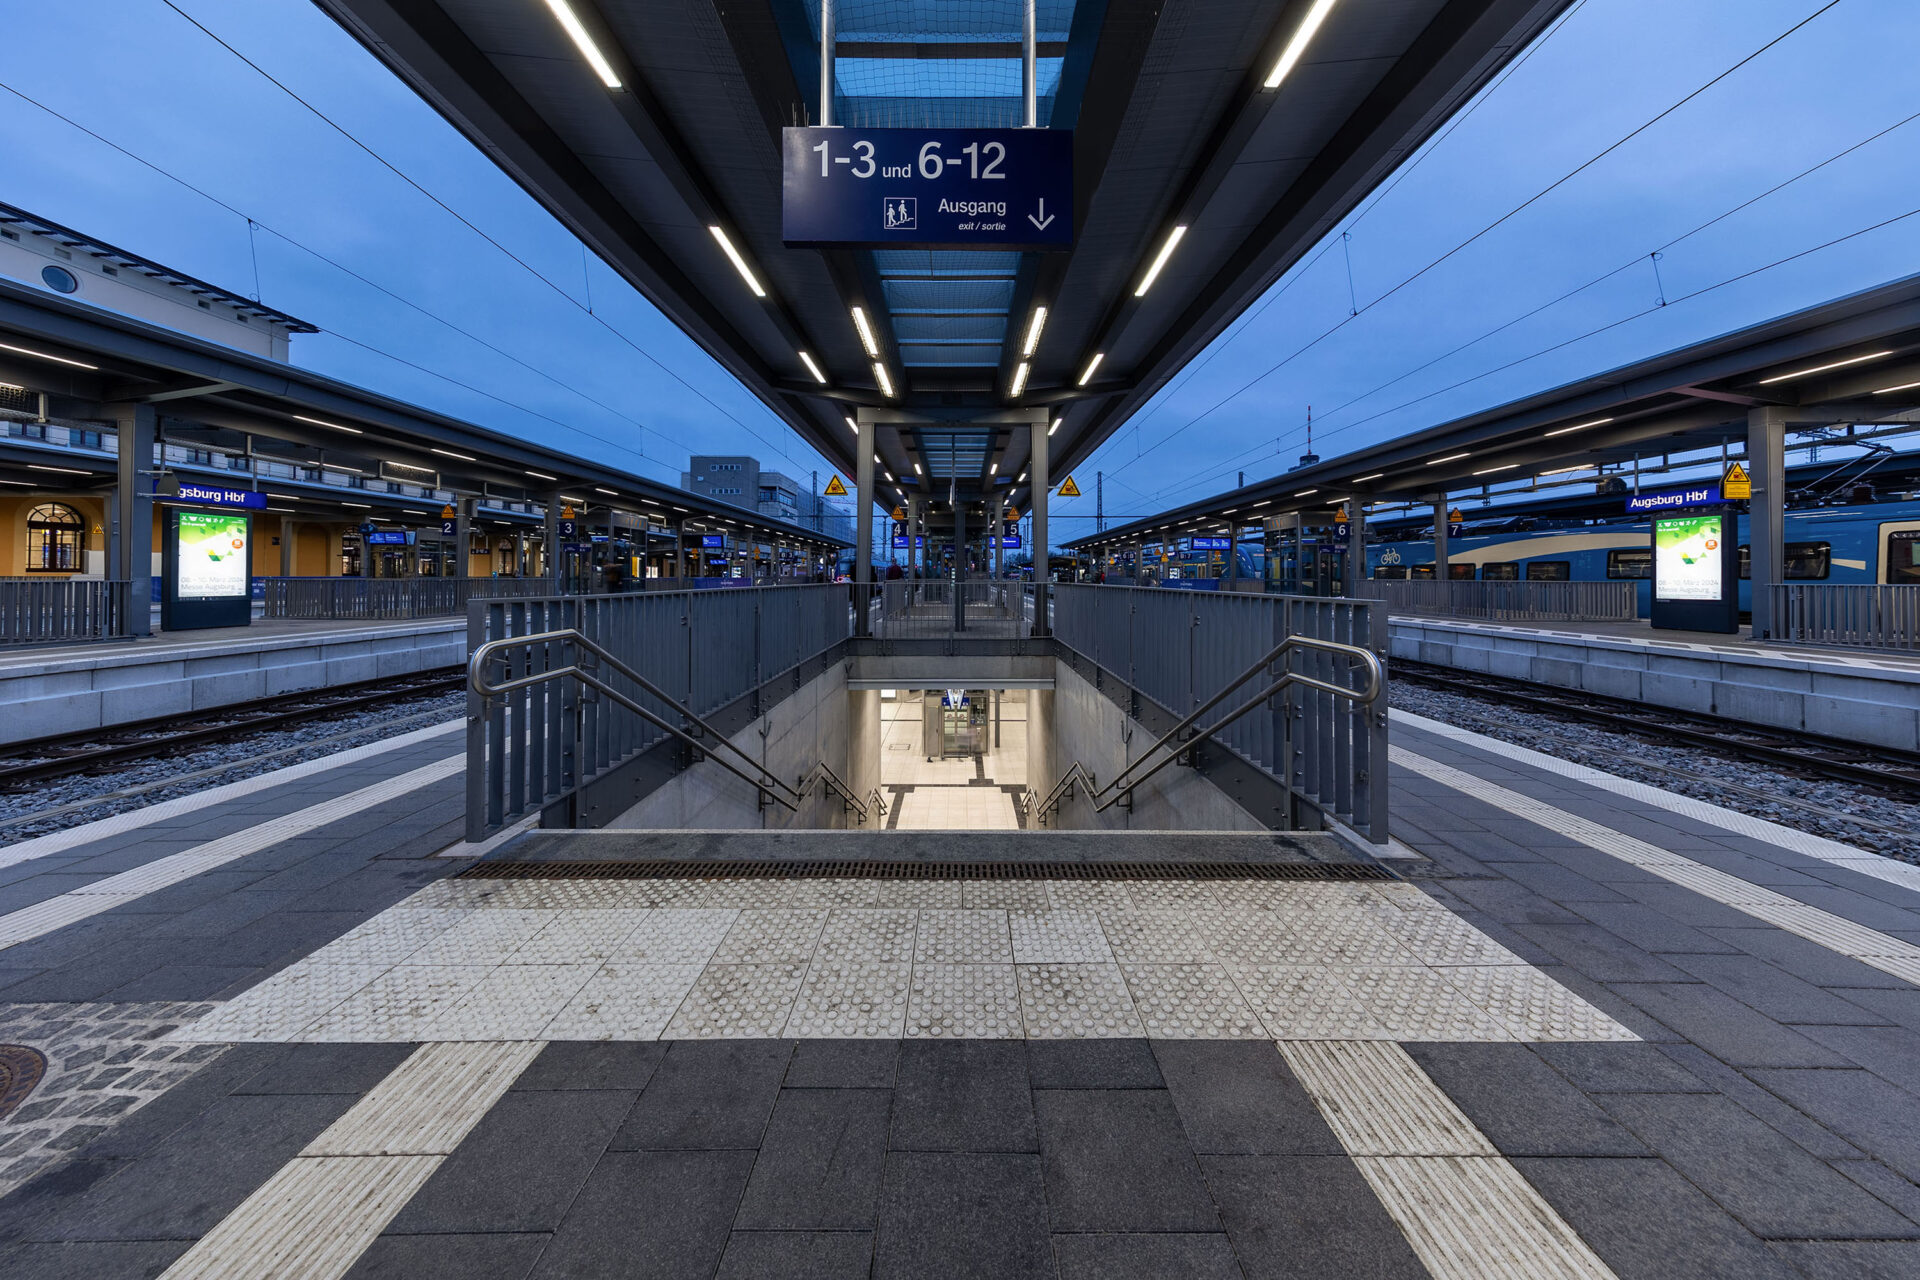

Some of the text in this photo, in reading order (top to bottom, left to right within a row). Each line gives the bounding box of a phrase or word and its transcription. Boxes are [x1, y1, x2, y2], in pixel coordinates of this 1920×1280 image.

[882, 163, 912, 178] und
[918, 141, 1006, 179] 6-12
[938, 198, 1006, 217] Ausgang
[958, 222, 974, 231] exit
[981, 222, 1006, 231] sortie
[178, 487, 246, 503] gsburg Hbf
[1630, 490, 1708, 508] Augsburg Hbf
[443, 522, 452, 533] 2
[564, 522, 573, 534] 3
[894, 524, 902, 535] 4
[1010, 524, 1018, 535] 5
[1338, 524, 1346, 536] 6
[1451, 525, 1459, 536] 7
